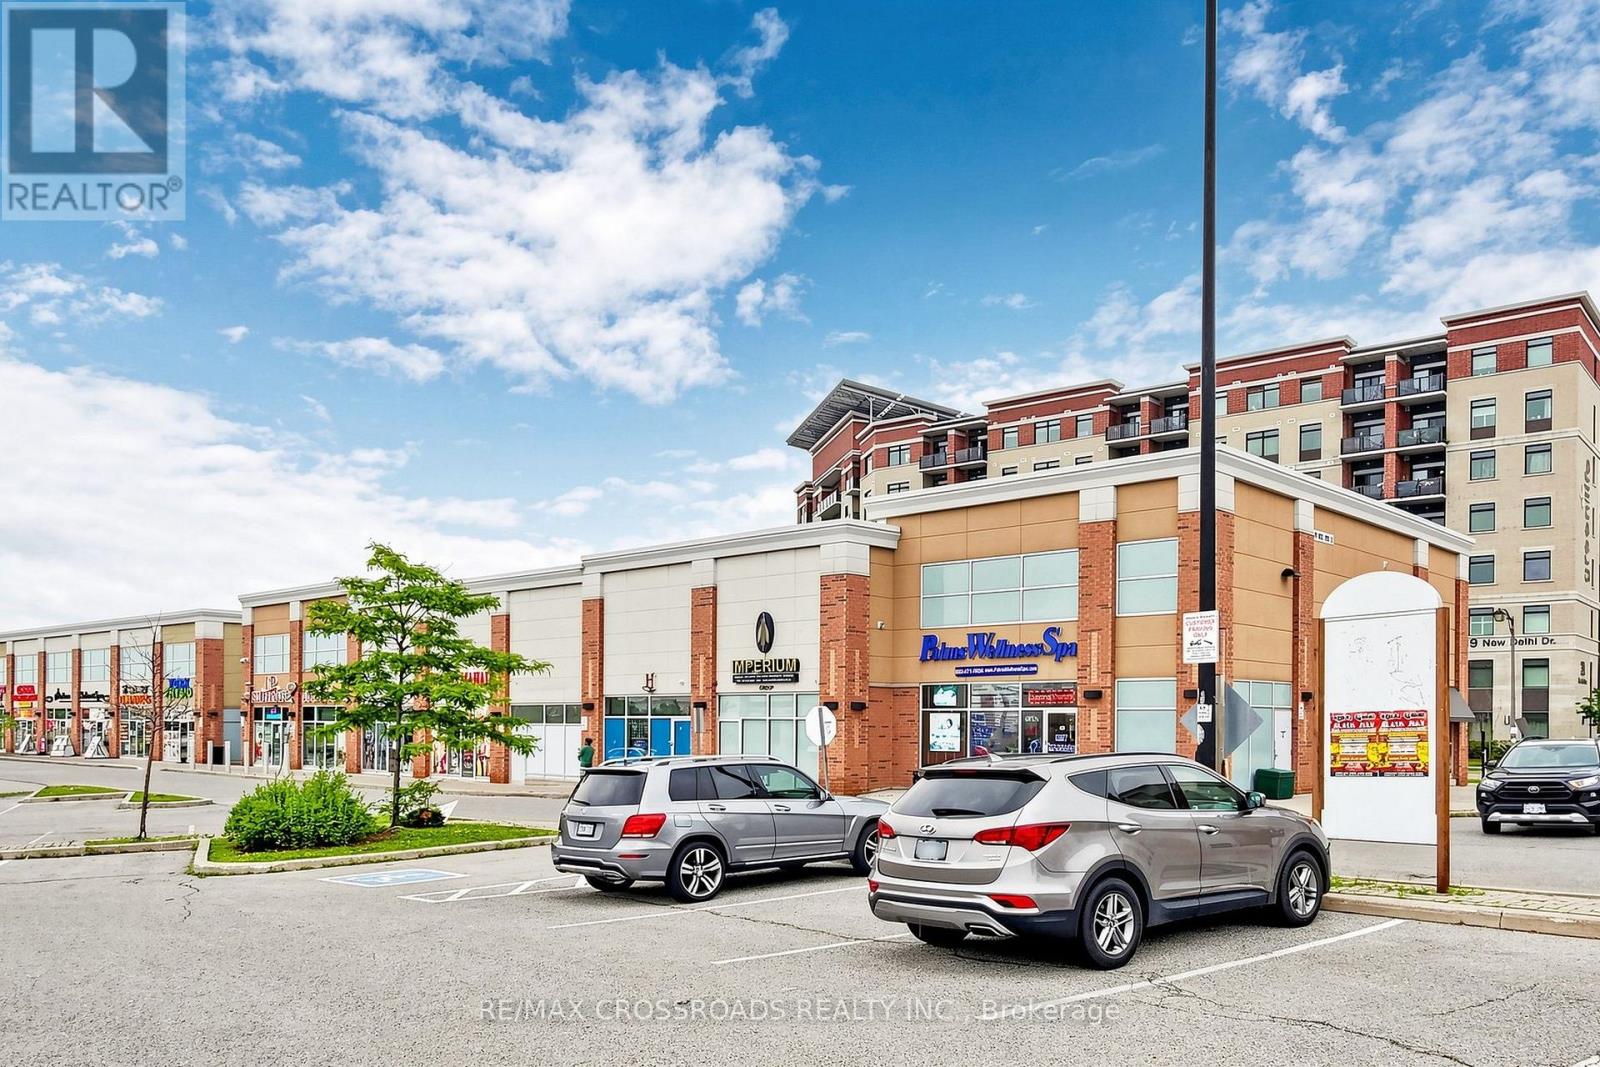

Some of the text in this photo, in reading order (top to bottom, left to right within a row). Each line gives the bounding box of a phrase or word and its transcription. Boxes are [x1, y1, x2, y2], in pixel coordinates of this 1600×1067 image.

[967, 632, 1043, 660] Wellness
[1043, 626, 1078, 662] Spa
[1541, 636, 1557, 645] Dr.
